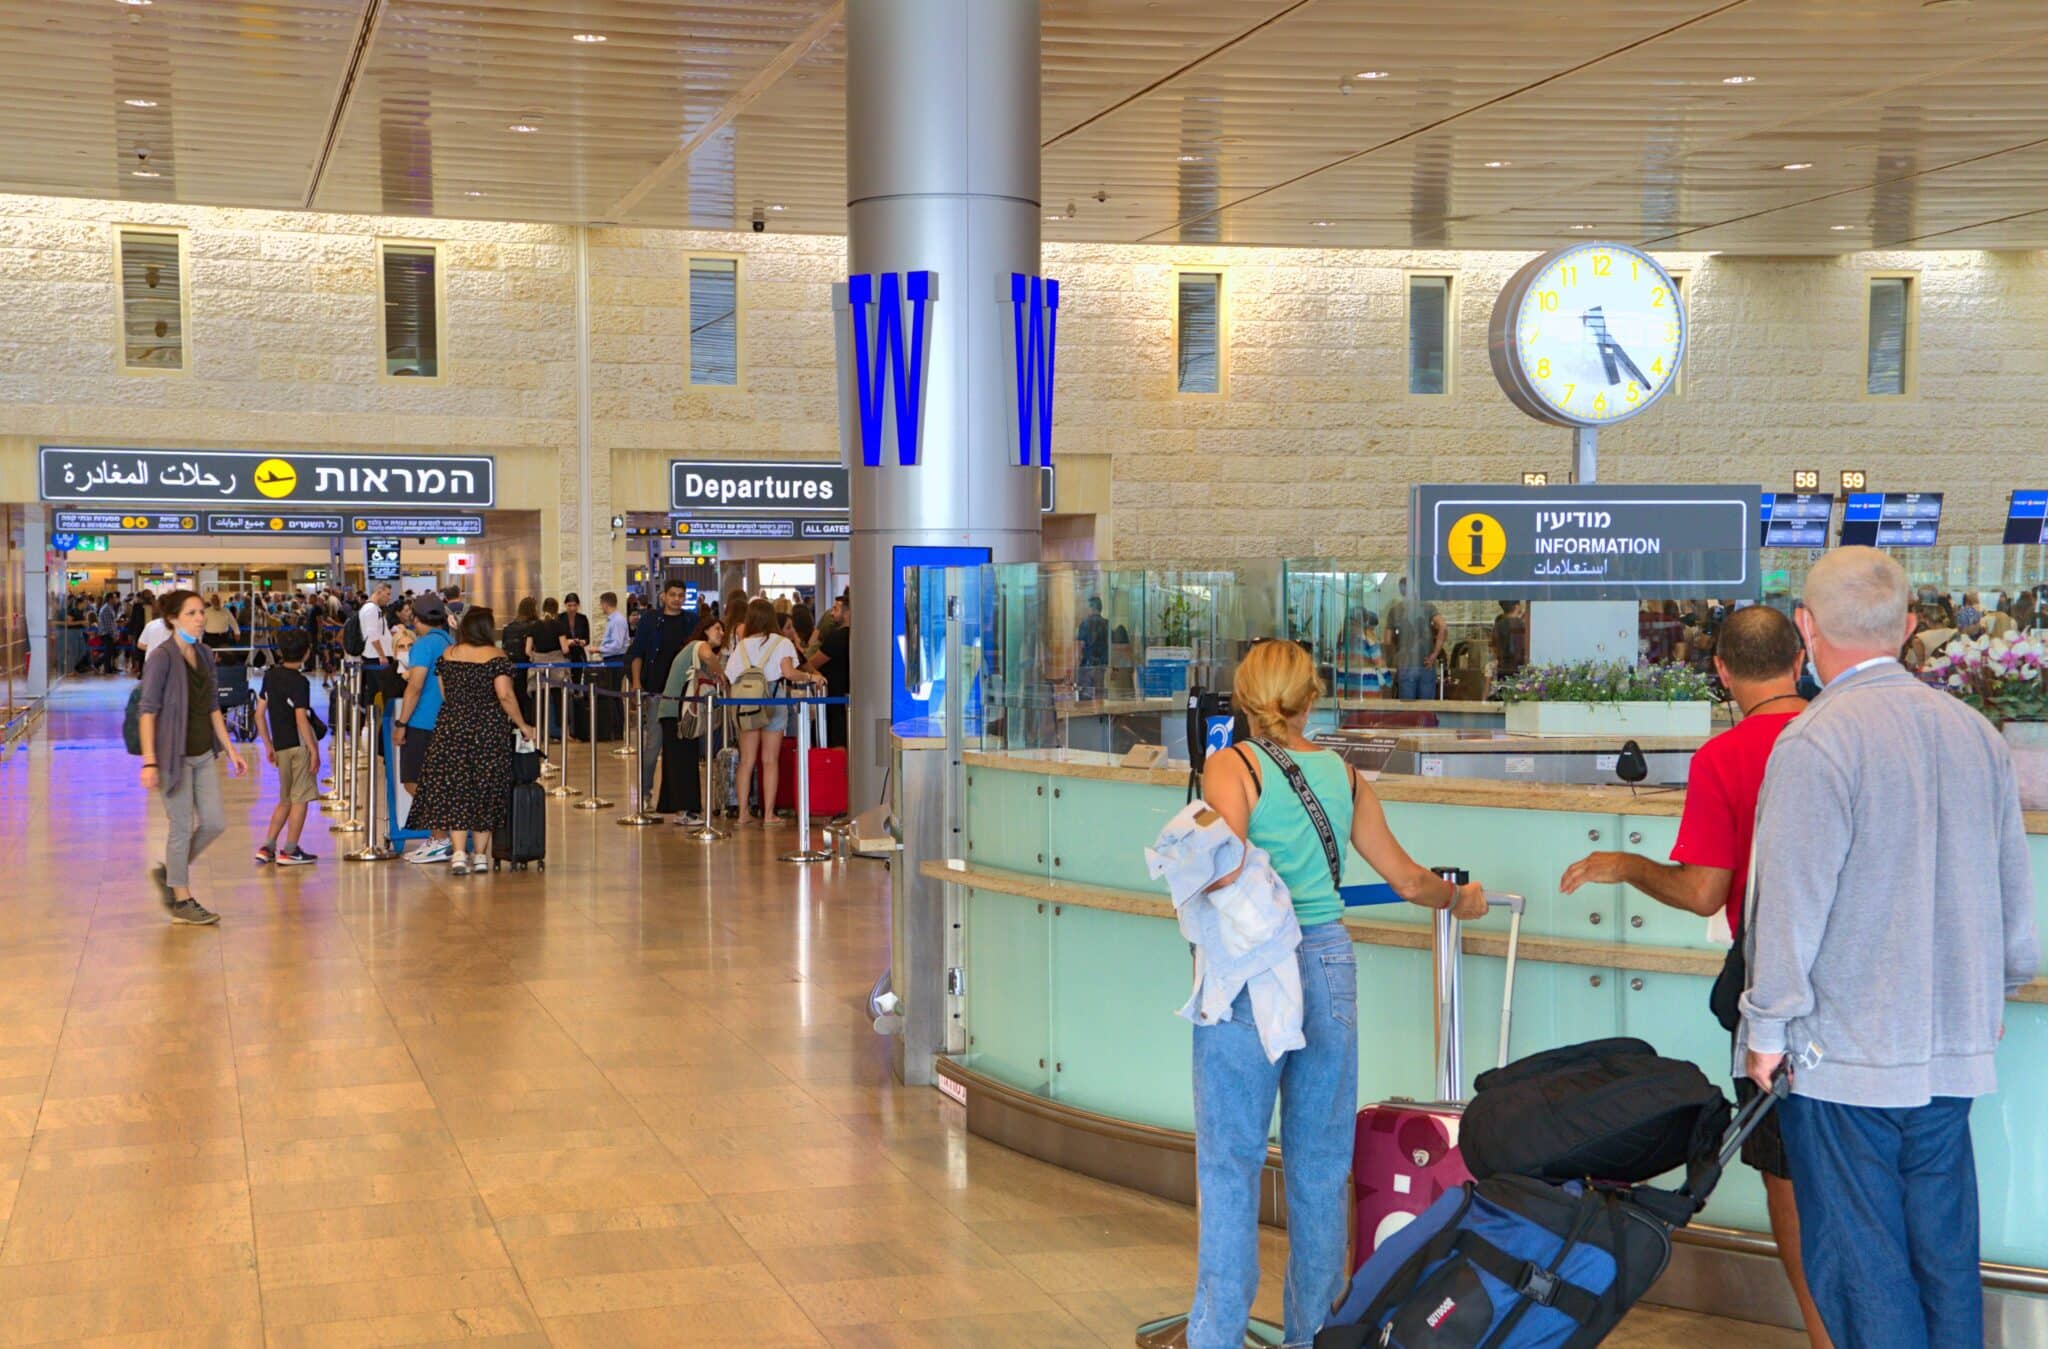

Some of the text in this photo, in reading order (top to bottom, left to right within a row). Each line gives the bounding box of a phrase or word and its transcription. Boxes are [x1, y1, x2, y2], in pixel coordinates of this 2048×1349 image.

[1592, 255, 1612, 277] 12
[1631, 263, 1639, 281] 1
[1561, 266, 1577, 288] 11
[1538, 291, 1559, 312] 10
[1651, 287, 1665, 307] 2
[849, 271, 929, 467] W
[1012, 272, 1060, 467] W
[1536, 358, 1551, 379] 8
[1651, 356, 1663, 375] 4
[1562, 384, 1575, 404] 7
[1593, 391, 1607, 412] 6
[1625, 380, 1640, 403] 5
[64, 459, 236, 494] رحلات المغادرة
[316, 466, 475, 494] המראות
[1796, 472, 1817, 488] 58
[1842, 472, 1865, 488] 59
[685, 473, 834, 503] Departures
[805, 525, 822, 533] ALL
[1535, 511, 1611, 531] מודיעין
[1535, 537, 1661, 555] INFORMATION
[1534, 559, 1608, 576] استعلامات
